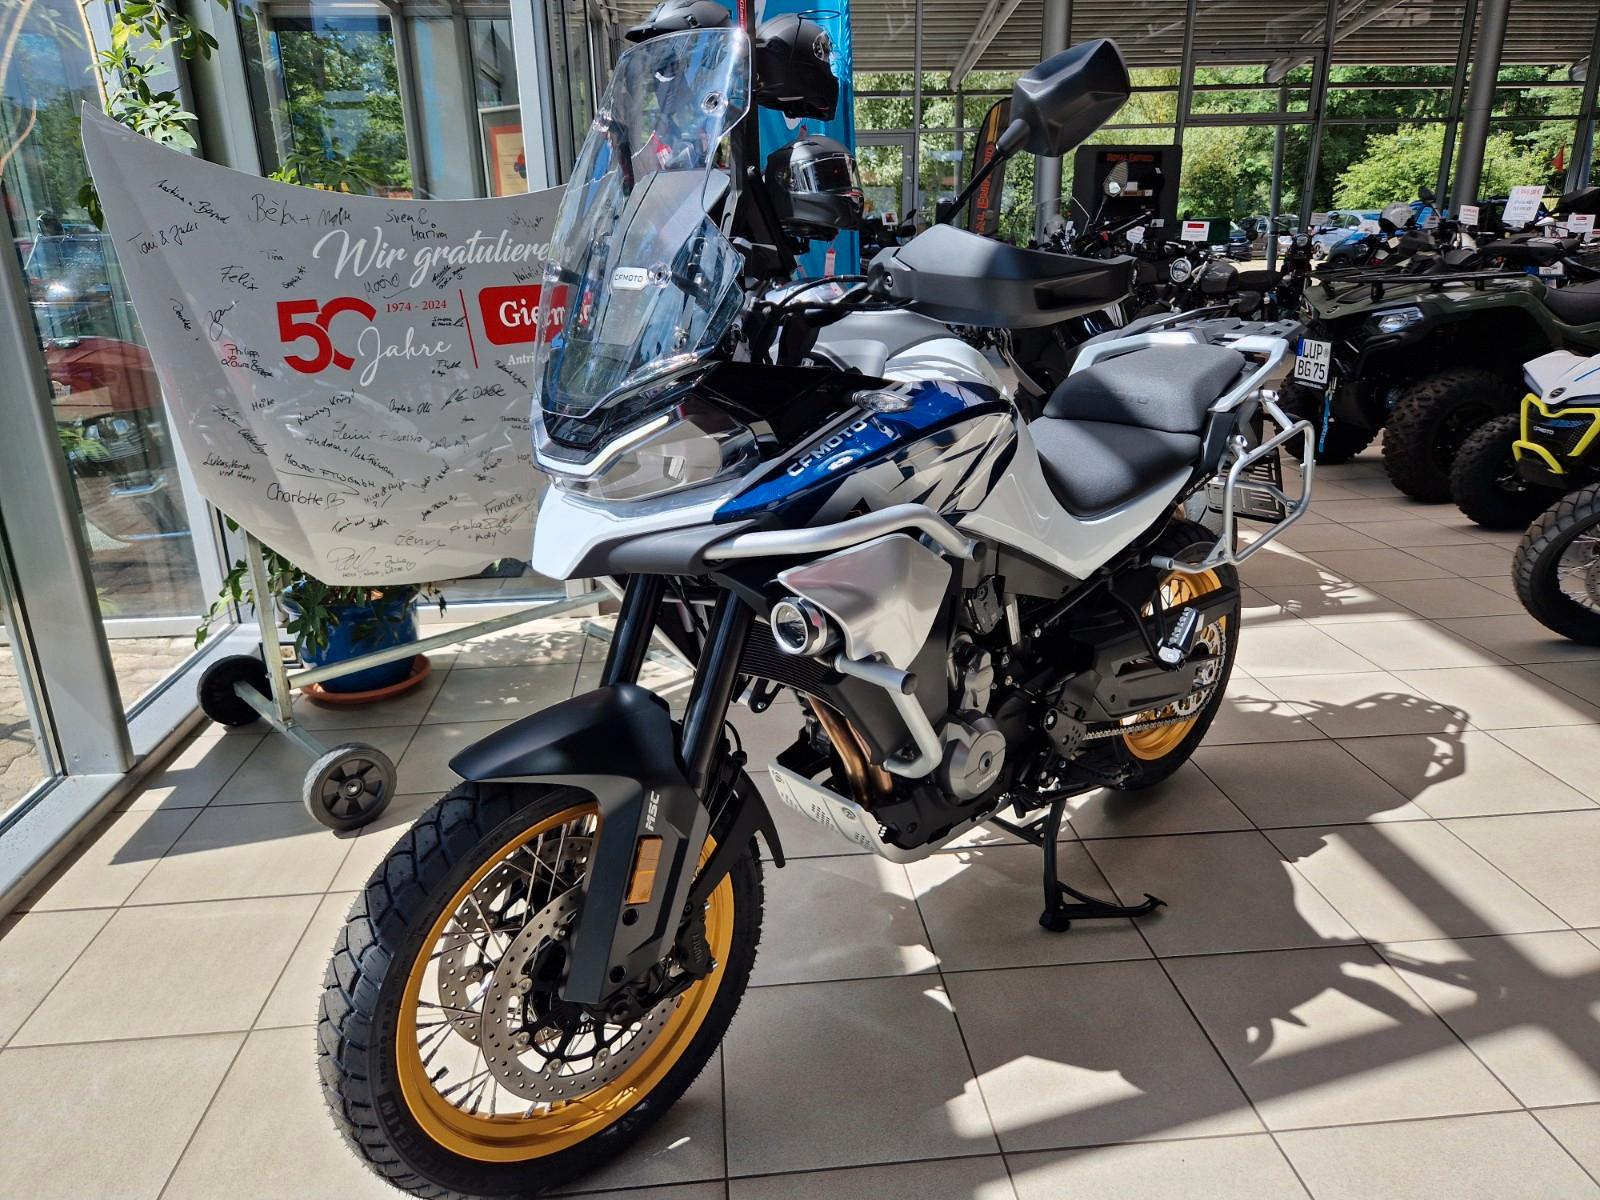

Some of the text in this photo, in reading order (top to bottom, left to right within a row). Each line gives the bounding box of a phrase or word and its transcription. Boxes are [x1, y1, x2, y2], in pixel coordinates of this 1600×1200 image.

[312, 226, 408, 280] Wir
[220, 264, 260, 291] Felix
[614, 273, 644, 283] CFMOTO
[385, 301, 412, 313] 1974
[421, 299, 448, 311] 2024
[357, 326, 453, 388] Jahre
[1302, 341, 1323, 360] LUP
[1297, 359, 1326, 381] BG 75
[786, 419, 868, 477] CFMOTO
[266, 482, 323, 506] Charlotte
[645, 790, 660, 832] MSC
